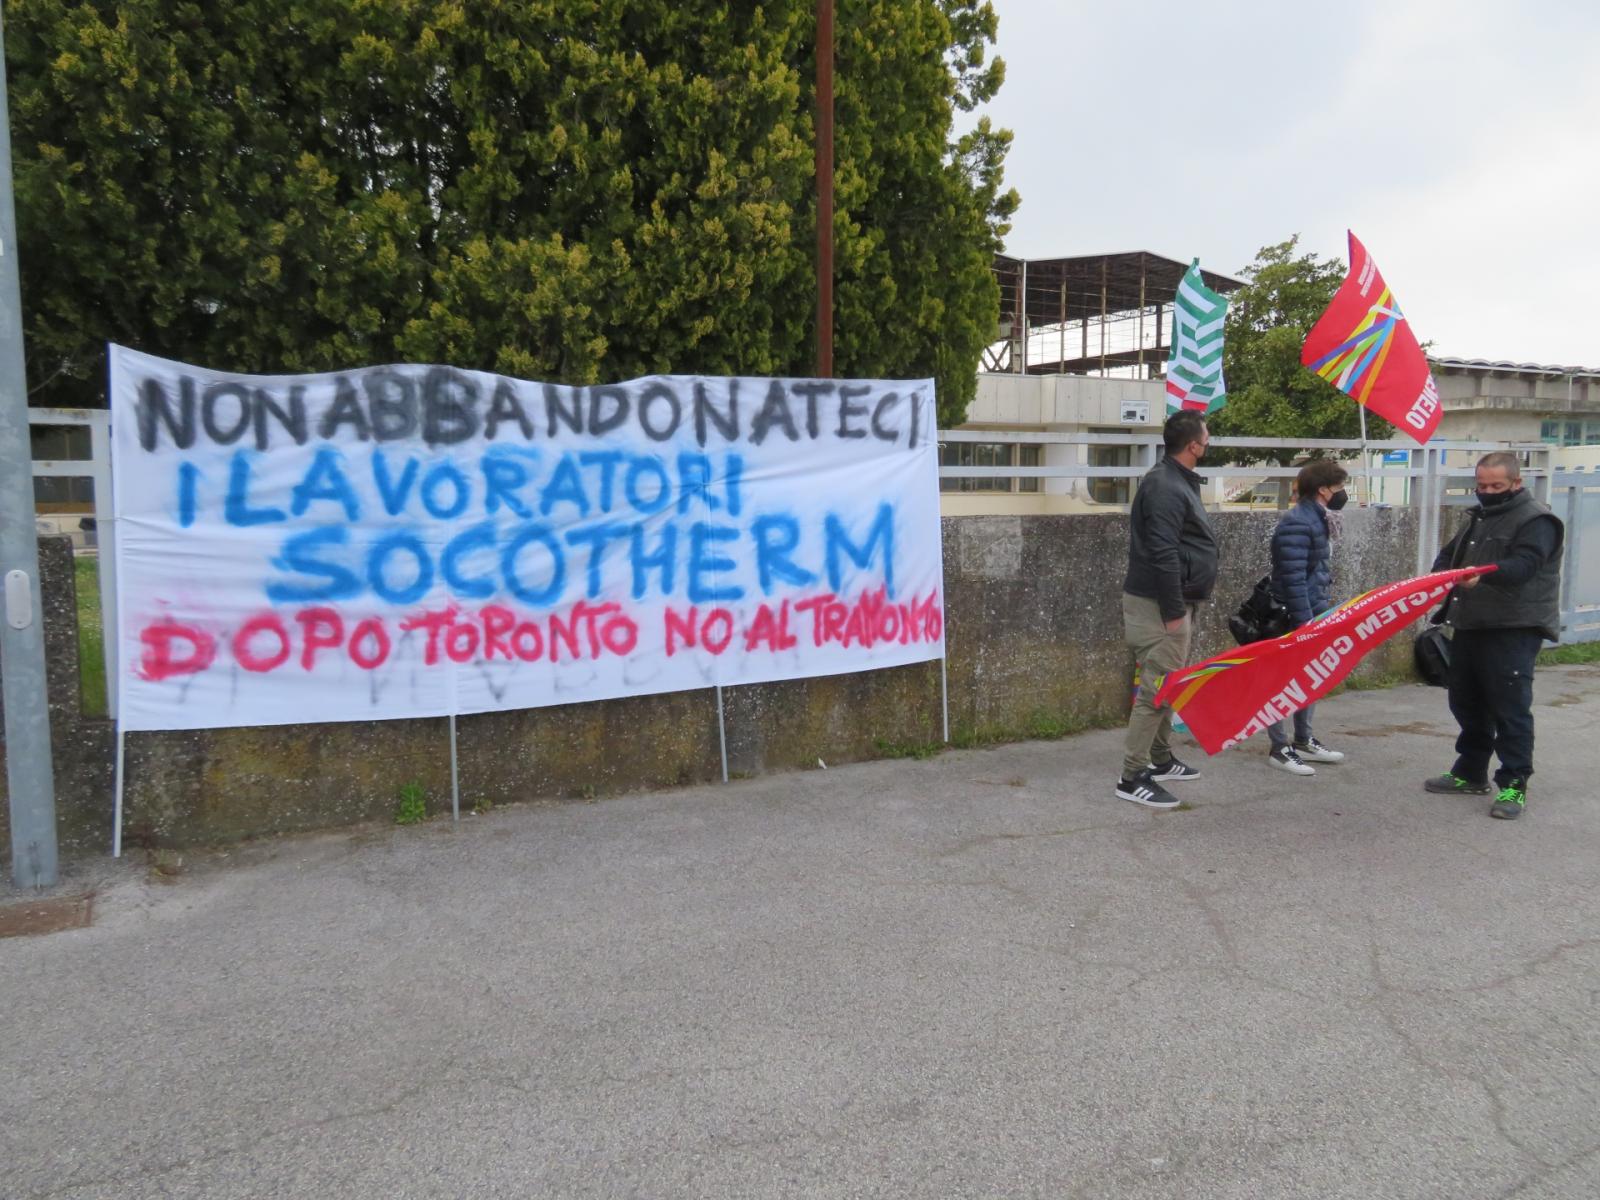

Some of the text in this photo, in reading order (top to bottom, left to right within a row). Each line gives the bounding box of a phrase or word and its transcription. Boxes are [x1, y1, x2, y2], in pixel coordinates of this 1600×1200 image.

[137, 366, 921, 451] NON ABBANDONATECI
[178, 446, 743, 528] I LAVORATORI
[266, 502, 895, 605] SOCOTHERM
[139, 606, 391, 681] DOPO
[401, 602, 638, 663] TORONTO
[665, 606, 733, 657] NO
